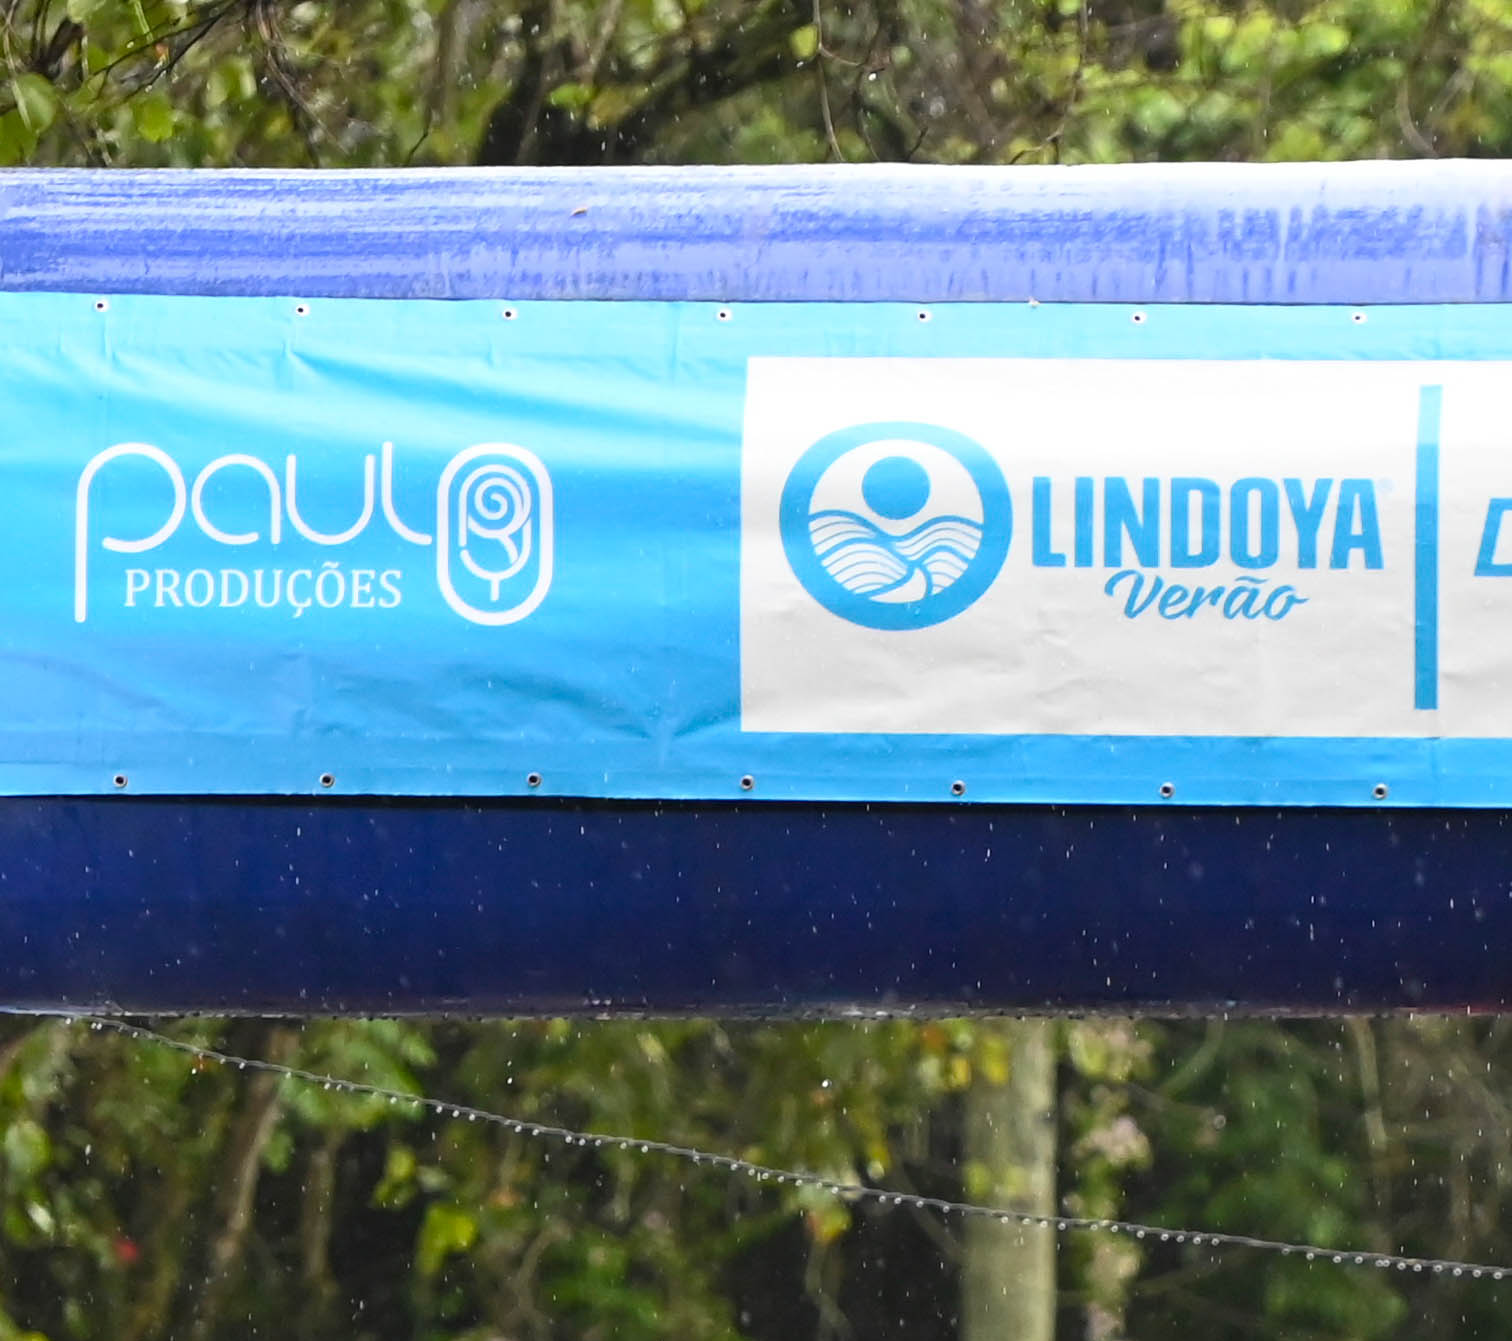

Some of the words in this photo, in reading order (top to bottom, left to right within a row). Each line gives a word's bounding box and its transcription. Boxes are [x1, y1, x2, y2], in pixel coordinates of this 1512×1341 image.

[1031, 476, 1385, 569] LINDOYA
[123, 561, 402, 618] PRODUÇÕES
[1103, 569, 1310, 620] Verão
